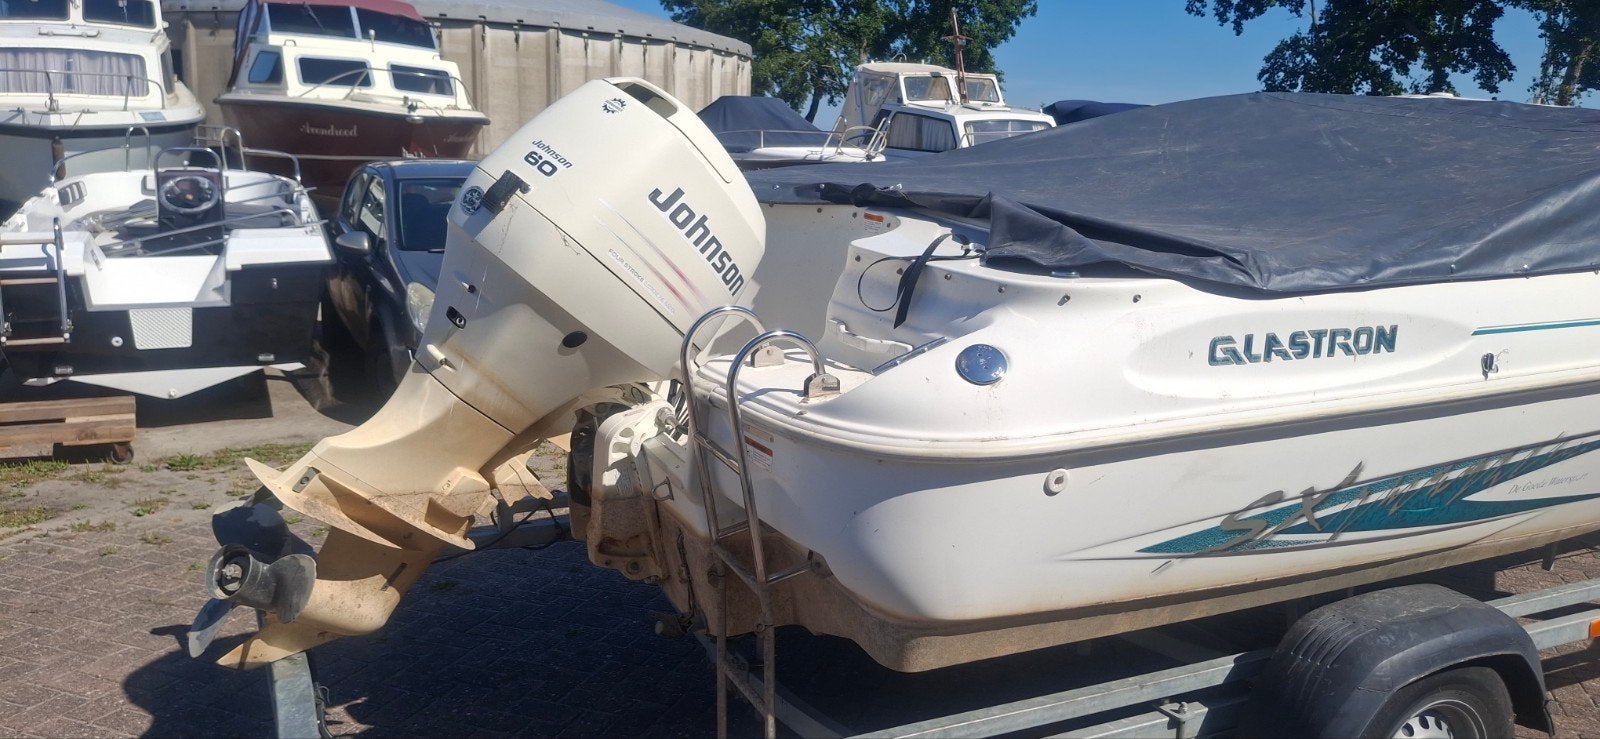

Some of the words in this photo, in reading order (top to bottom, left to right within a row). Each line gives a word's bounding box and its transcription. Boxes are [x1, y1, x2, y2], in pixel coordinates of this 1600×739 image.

[523, 150, 558, 177] 60
[531, 139, 573, 169] Johnson
[647, 186, 745, 297] Johnson
[608, 248, 625, 264] FOUR
[623, 262, 645, 283] STROKE
[1207, 324, 1399, 367] GLASTRON
